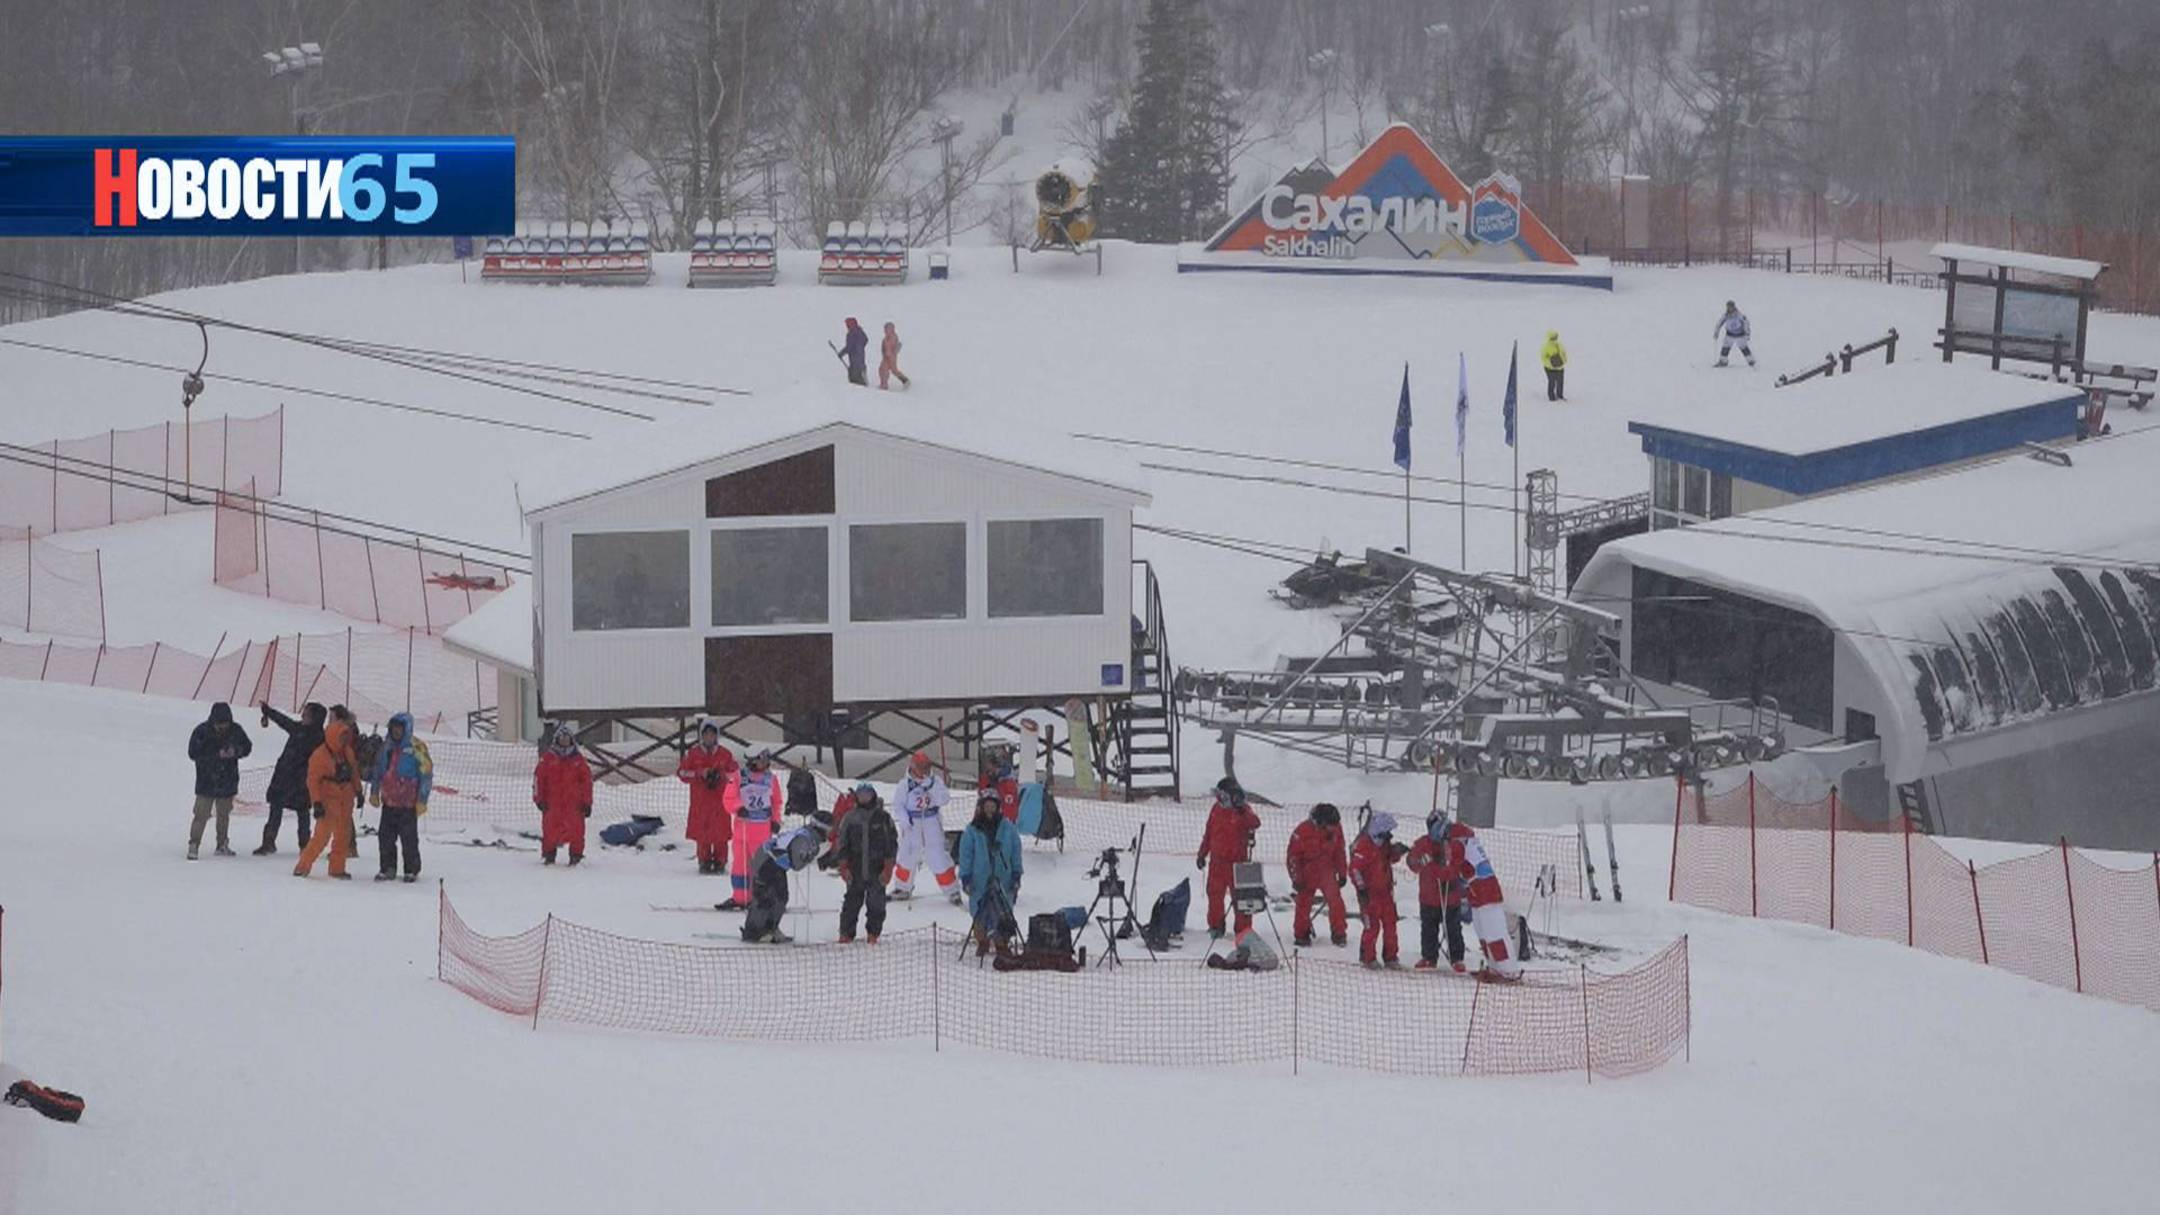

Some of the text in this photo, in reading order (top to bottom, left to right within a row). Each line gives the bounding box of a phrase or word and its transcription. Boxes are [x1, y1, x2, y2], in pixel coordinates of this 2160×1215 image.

[1262, 184, 1467, 236] Сахалин
[1263, 235, 1355, 258] Sakhalin
[748, 796, 765, 808] 26
